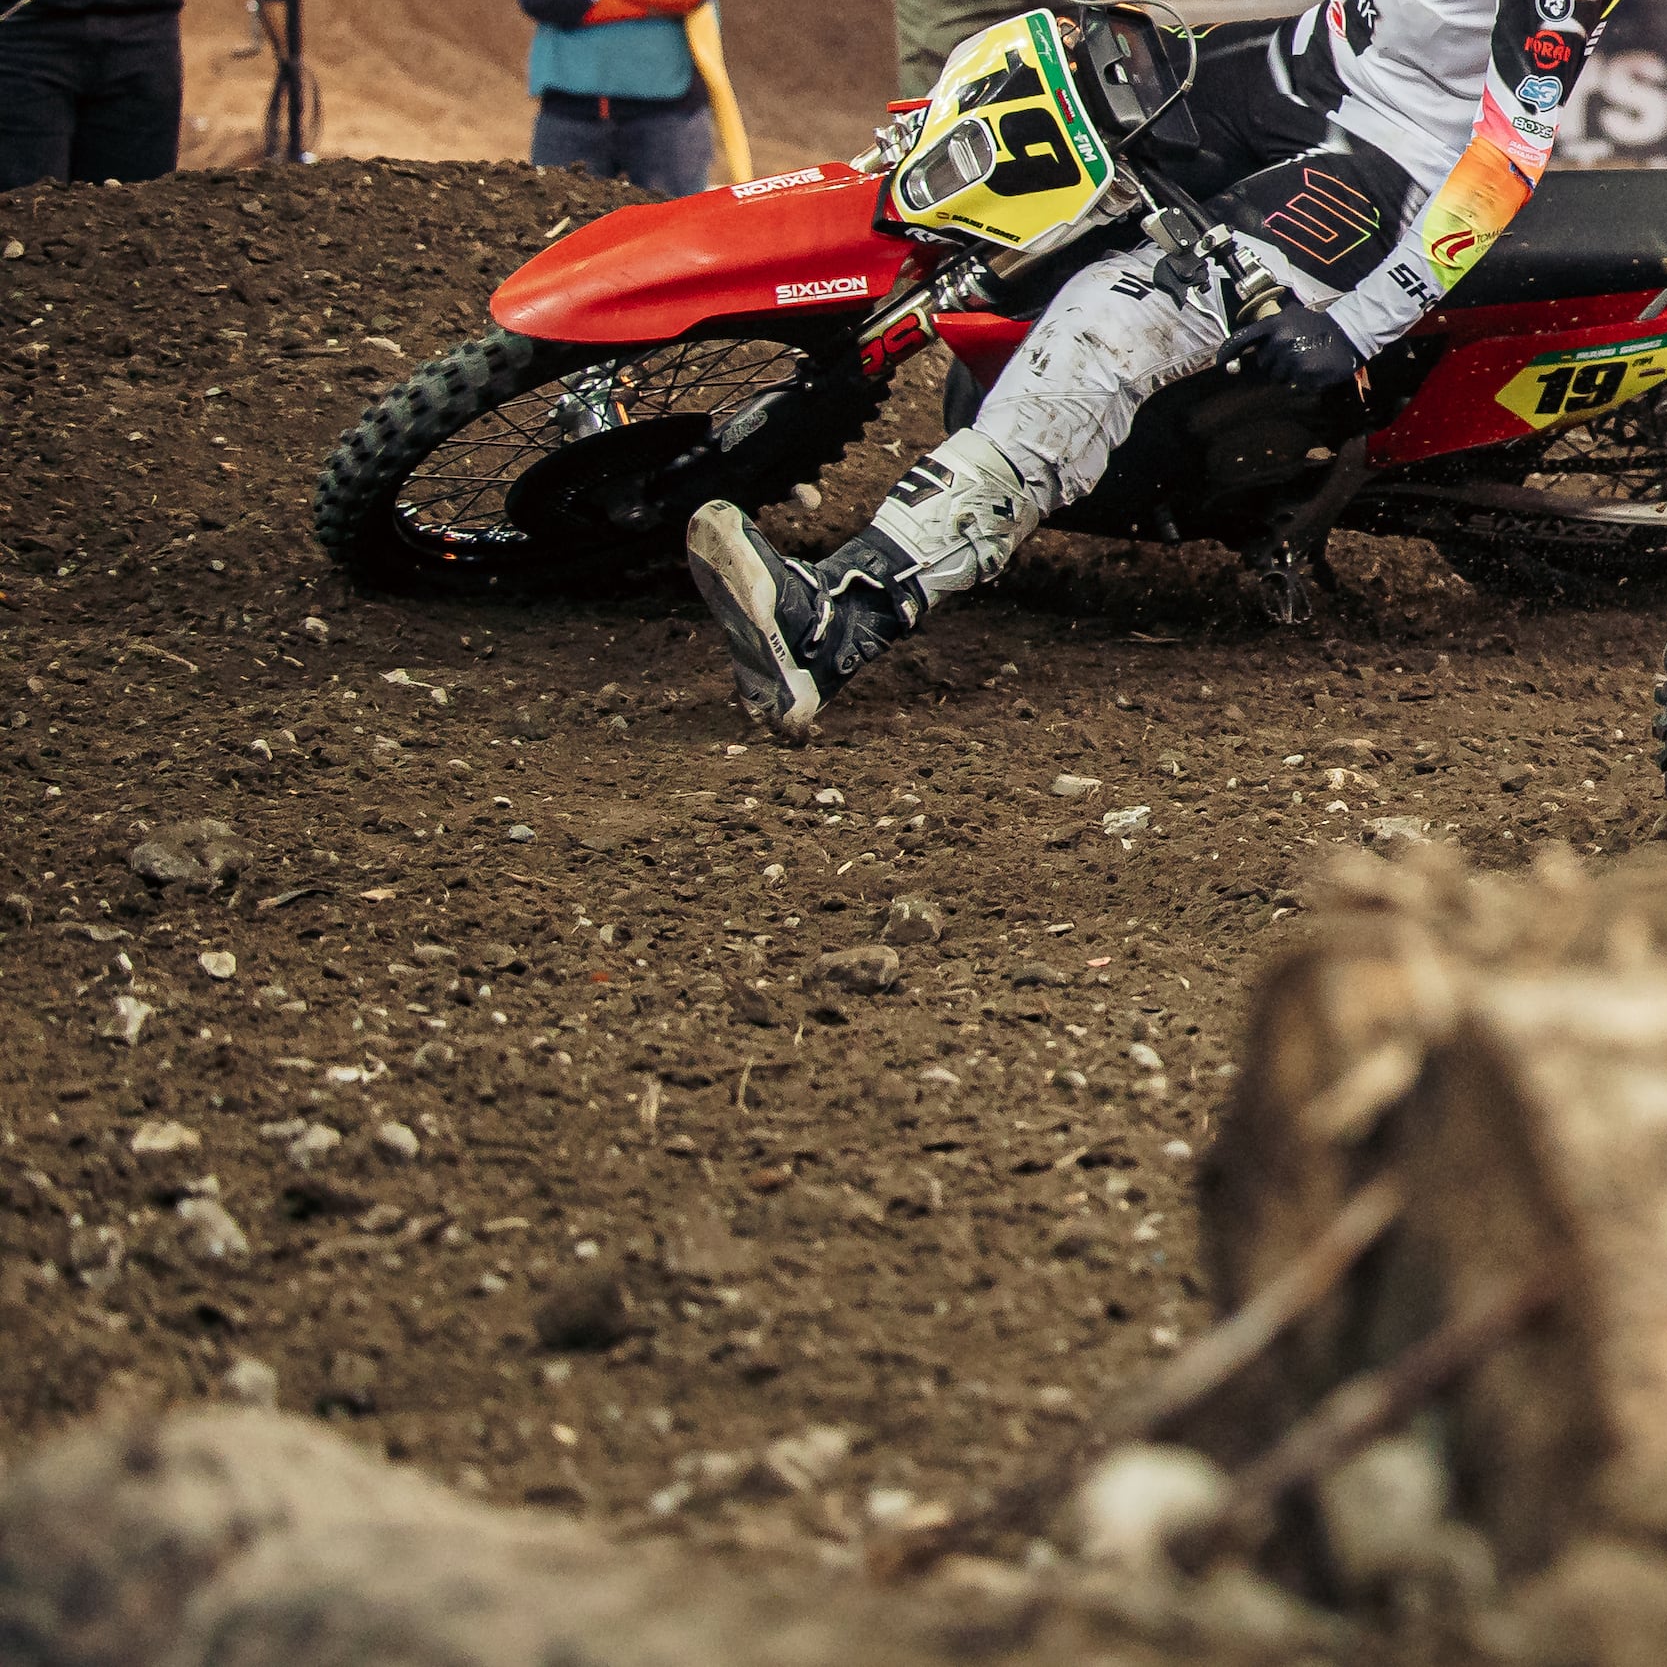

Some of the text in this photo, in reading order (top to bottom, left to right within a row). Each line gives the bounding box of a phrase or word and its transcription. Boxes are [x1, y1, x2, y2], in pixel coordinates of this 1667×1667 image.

[956, 48, 1084, 198] 19
[775, 275, 868, 299] SIXLYON
[1534, 361, 1629, 416] 19
